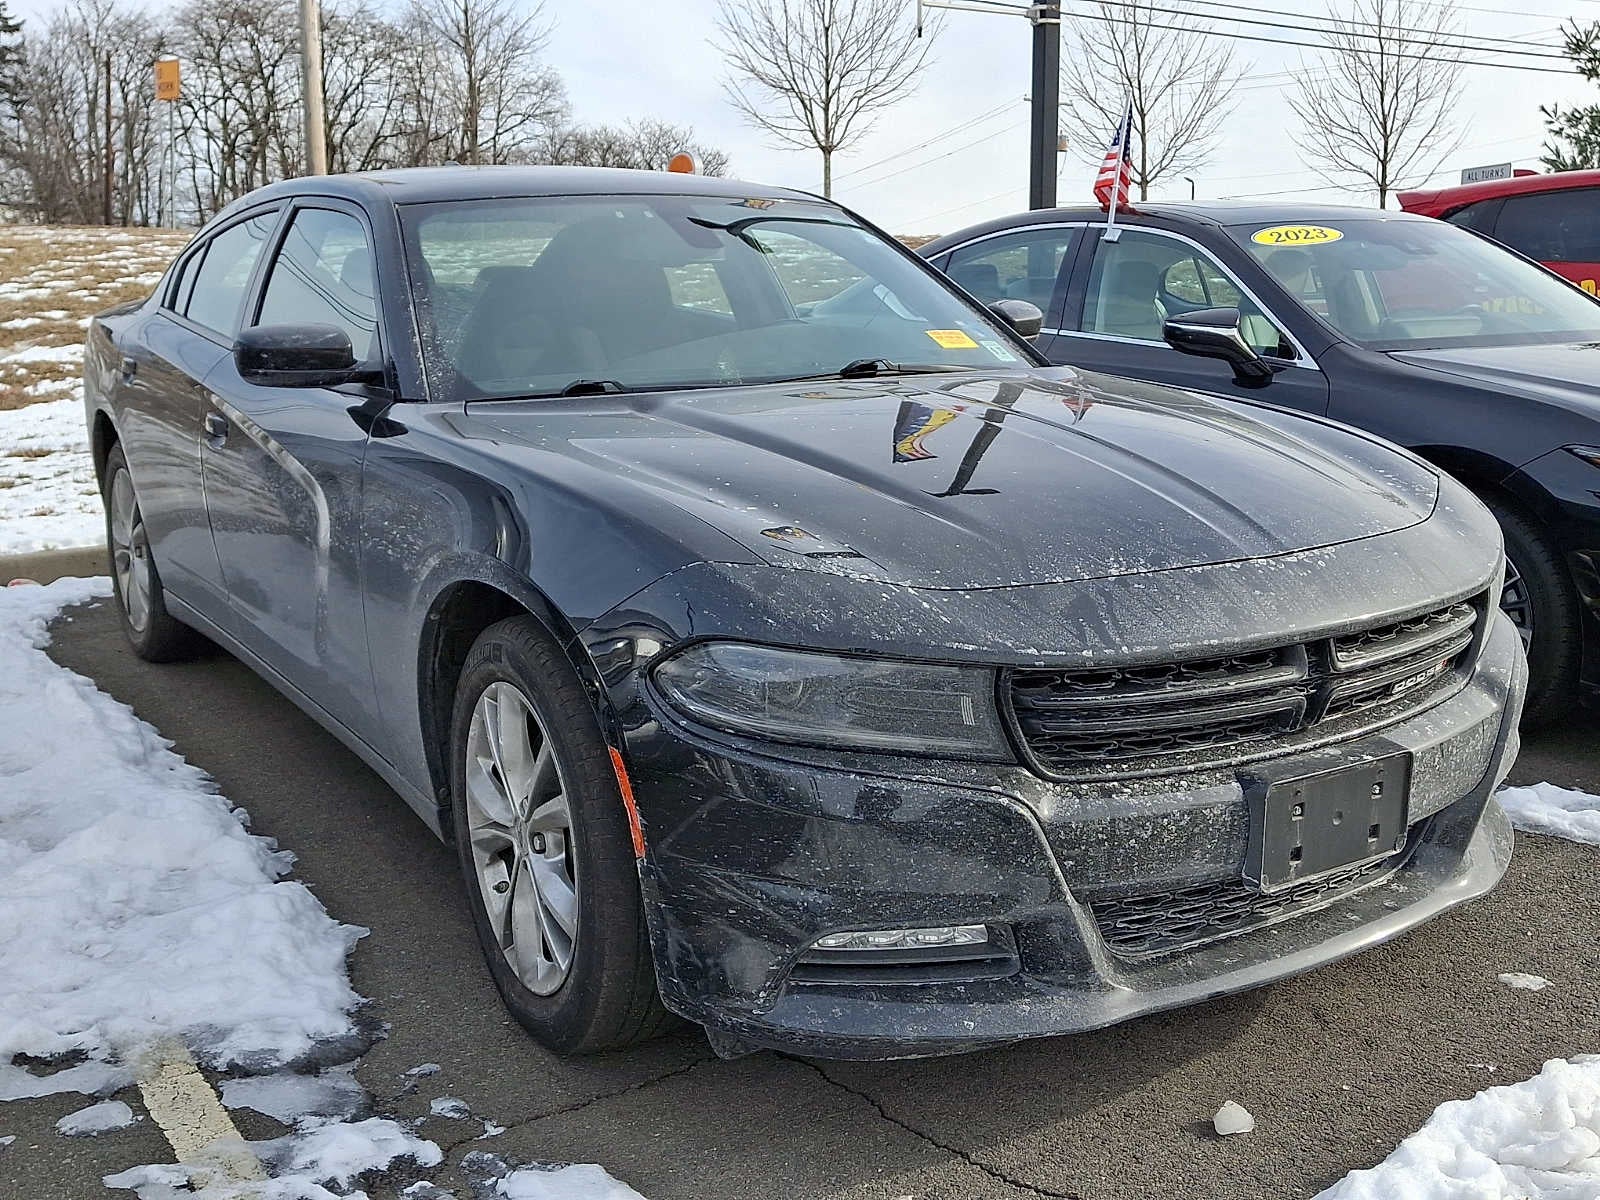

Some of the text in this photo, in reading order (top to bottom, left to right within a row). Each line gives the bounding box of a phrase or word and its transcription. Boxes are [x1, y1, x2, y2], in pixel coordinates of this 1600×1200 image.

[1467, 167, 1505, 181] ALL TURNS
[1269, 228, 1329, 243] 2023
